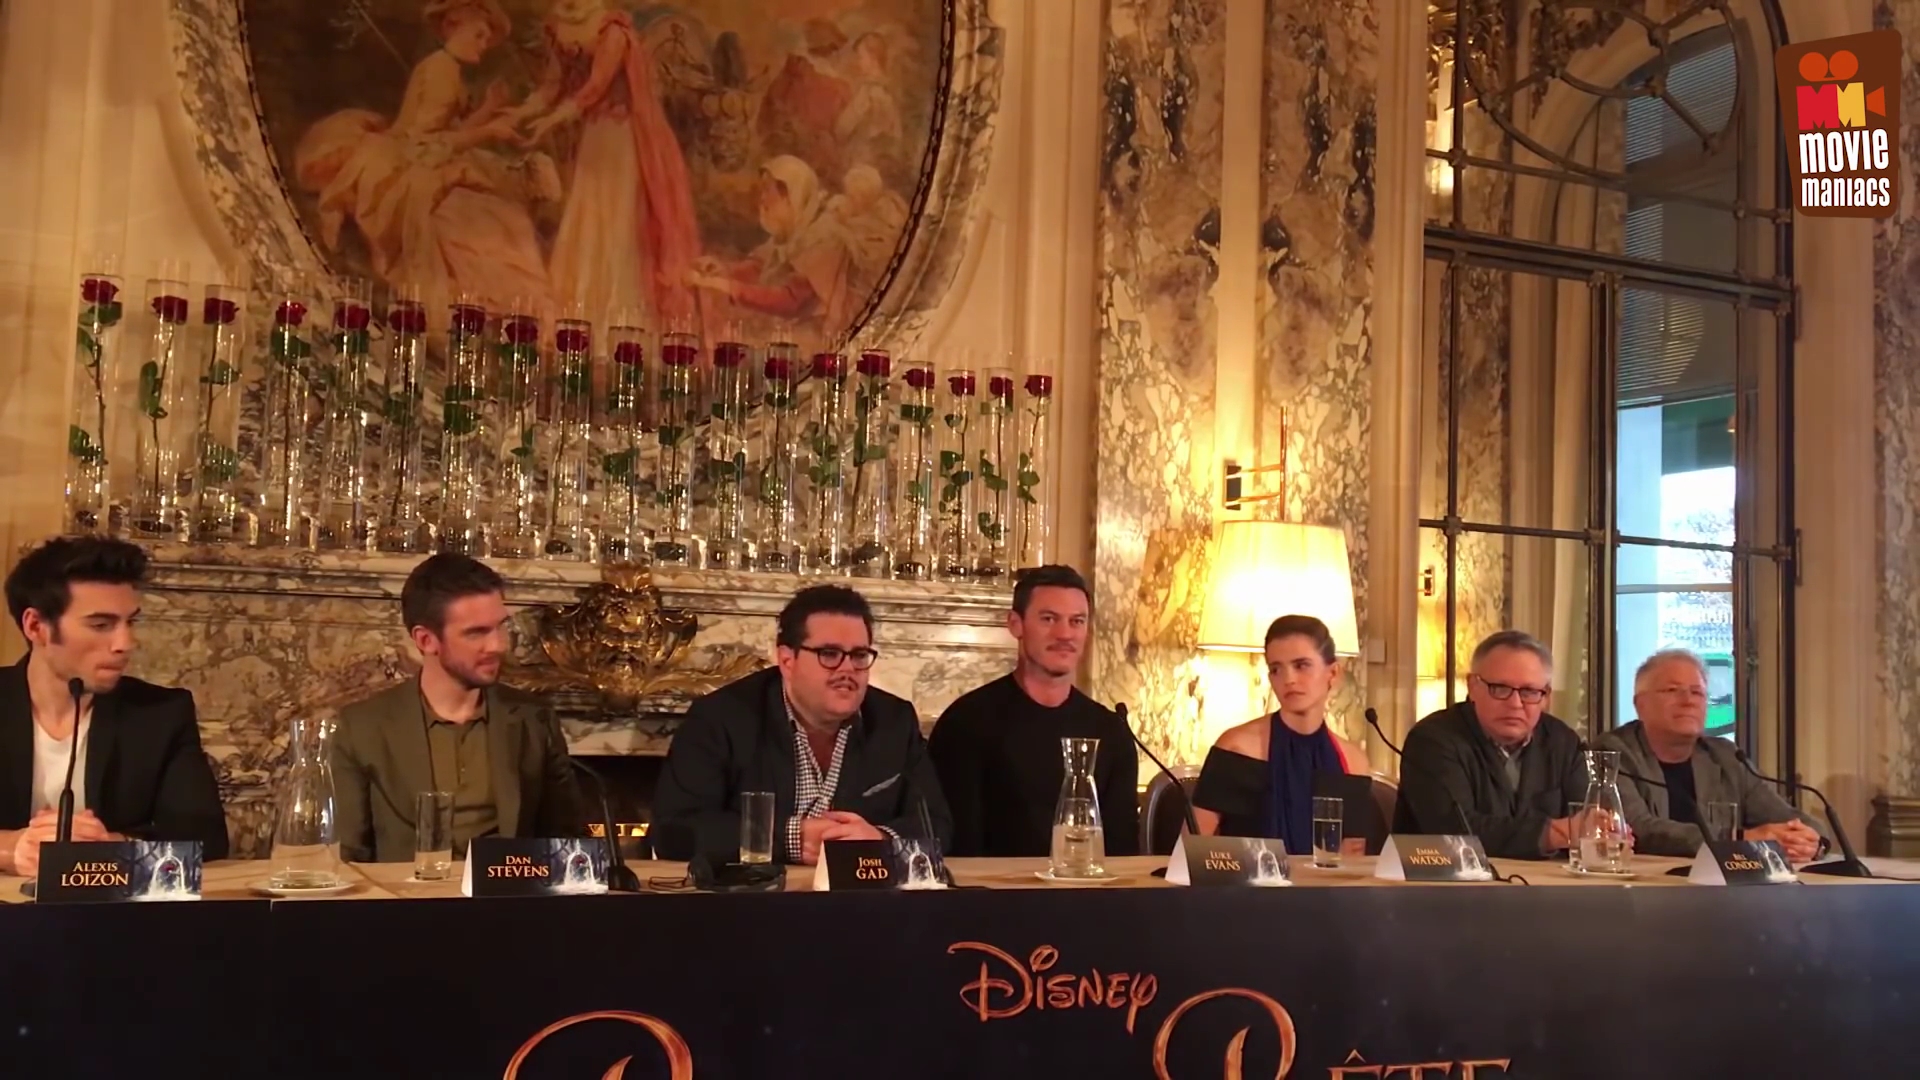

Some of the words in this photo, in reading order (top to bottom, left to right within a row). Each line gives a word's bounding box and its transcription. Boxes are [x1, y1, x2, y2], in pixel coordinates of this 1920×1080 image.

[505, 855, 531, 865] DAN
[1209, 850, 1233, 860] LUKE
[1409, 855, 1452, 866] WATSON
[72, 861, 118, 872] ALEXIS
[857, 857, 882, 868] JOSH
[1205, 859, 1241, 871] EVANS
[1724, 860, 1764, 871] CONDON
[487, 865, 549, 878] STEVENS
[856, 867, 889, 880] GAD
[60, 872, 129, 887] LOIZON
